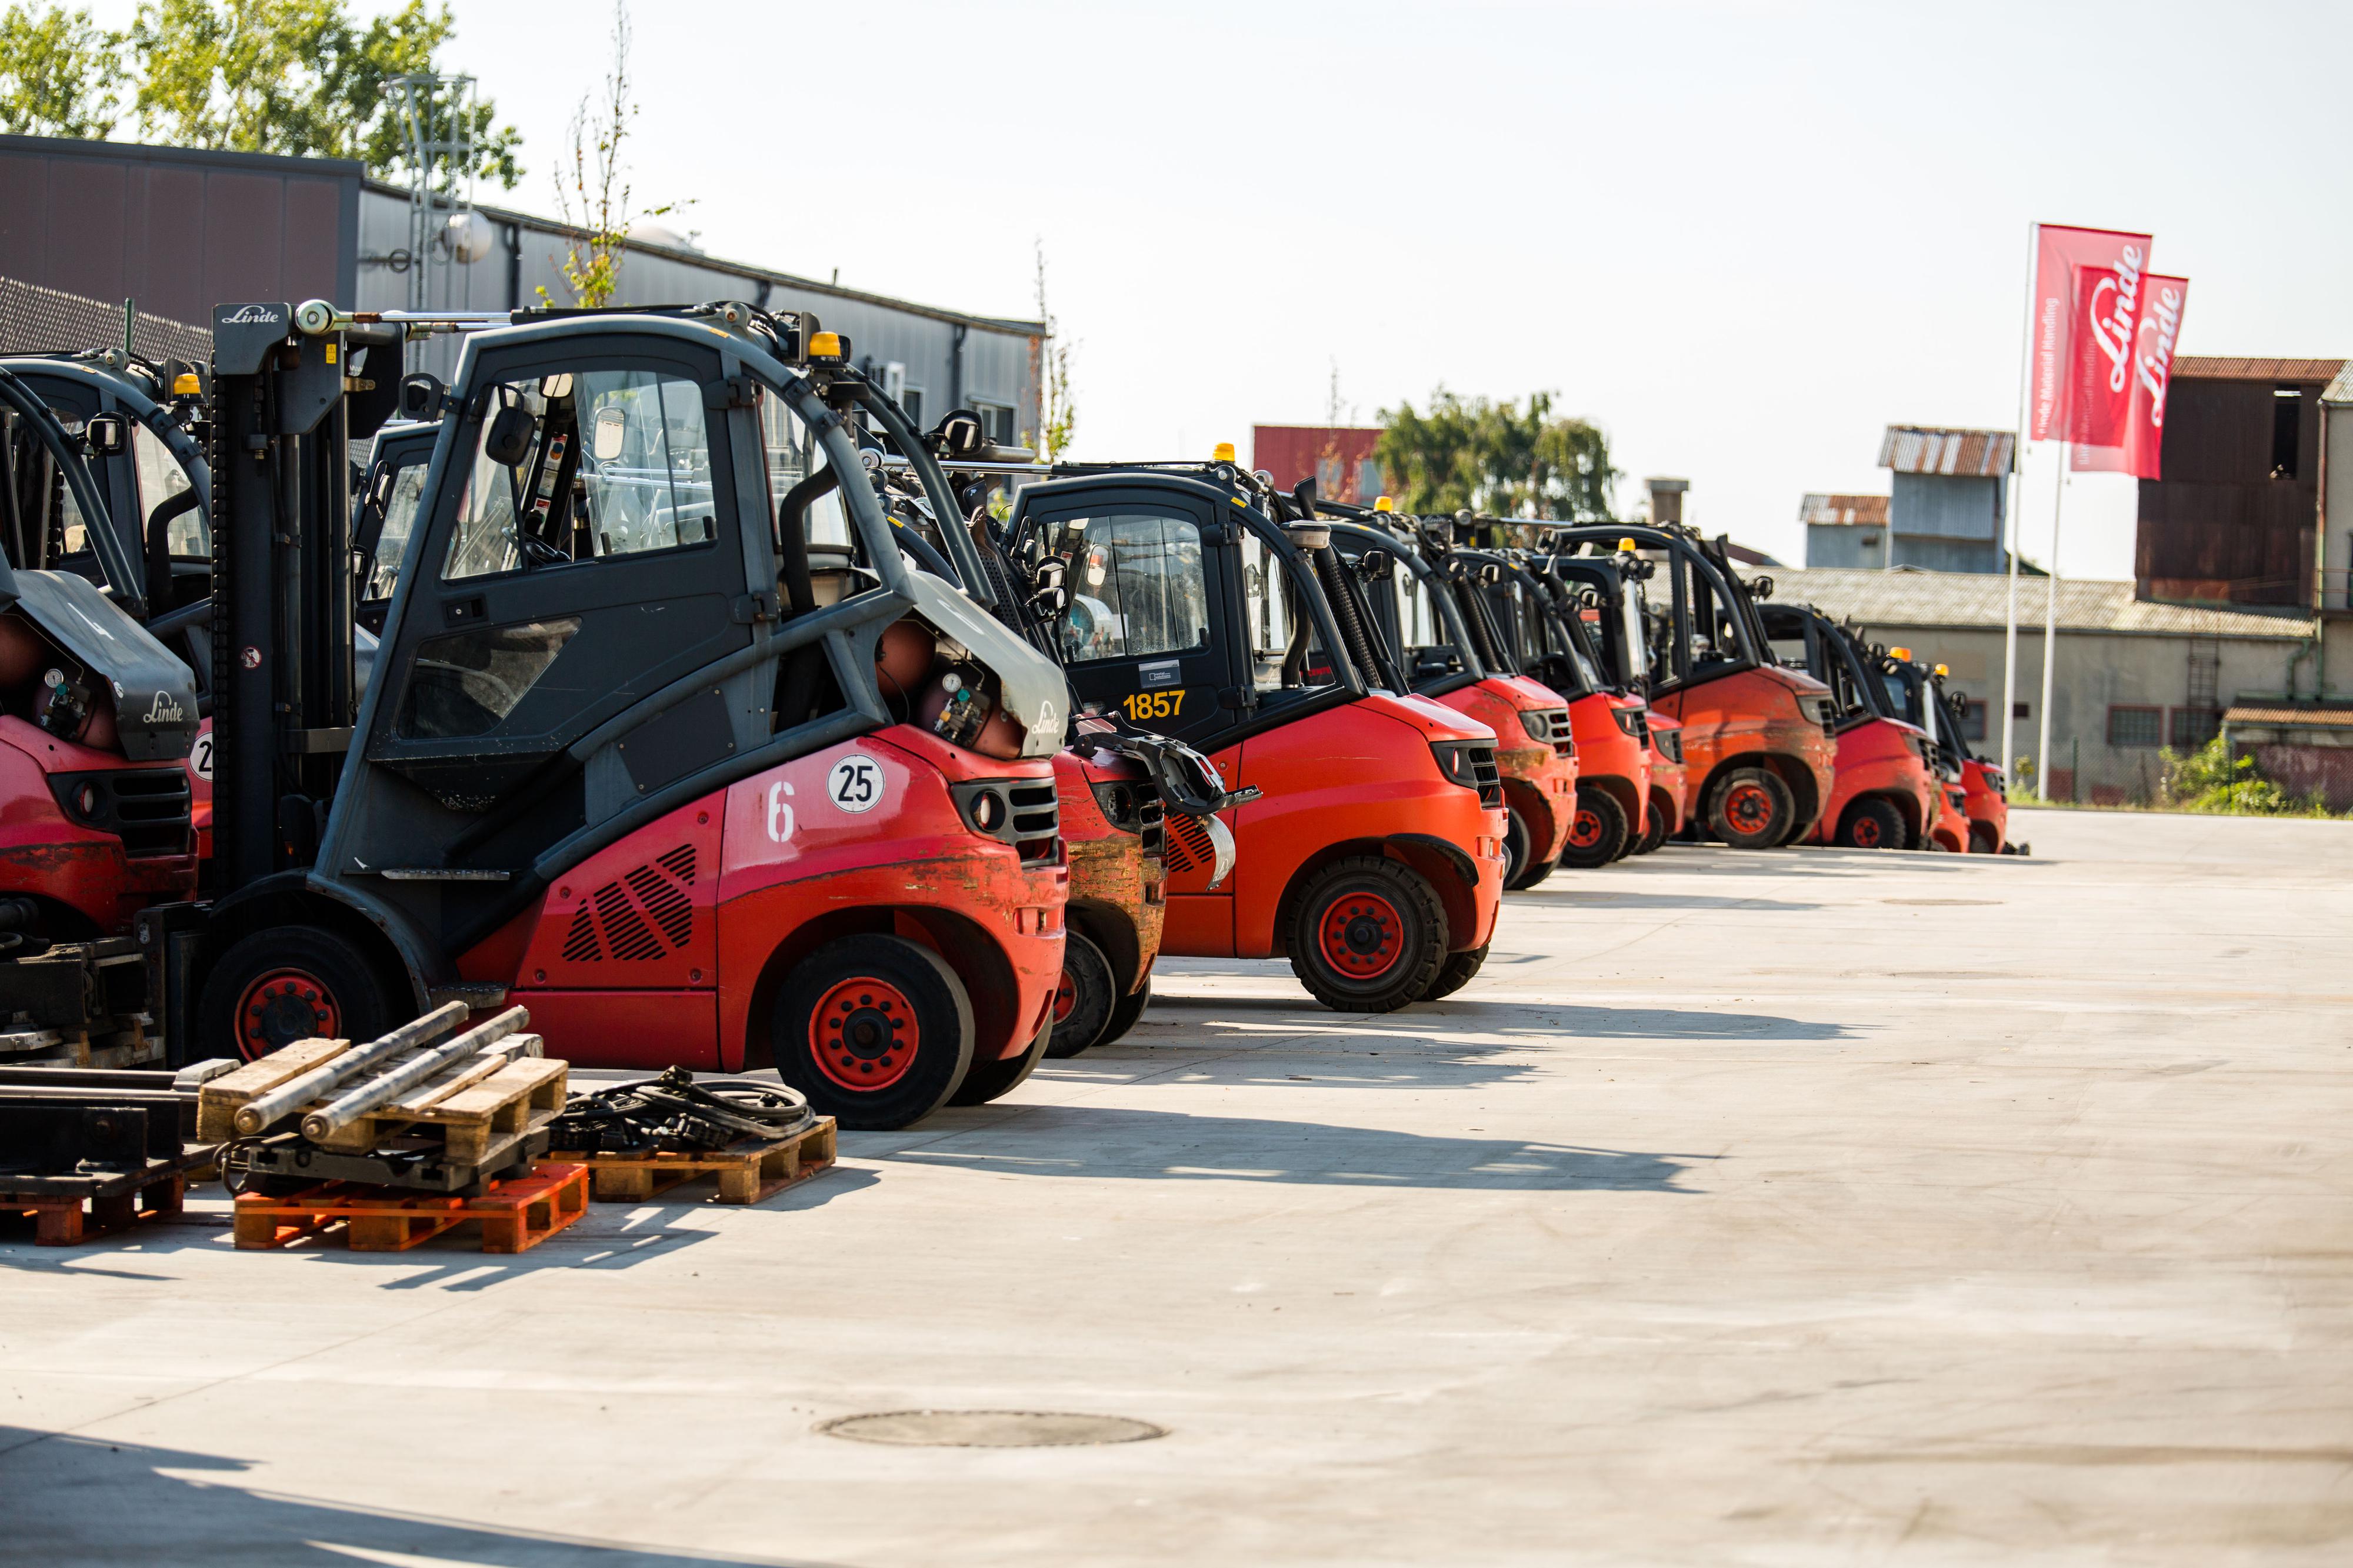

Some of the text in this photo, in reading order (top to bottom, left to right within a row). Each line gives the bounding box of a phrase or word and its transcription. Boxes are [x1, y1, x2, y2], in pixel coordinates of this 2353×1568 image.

[221, 305, 279, 323] Linde
[2041, 298, 2060, 351] Handling
[2090, 245, 2142, 393] Linde
[2039, 352, 2055, 401] Material
[2135, 287, 2181, 427] Linde
[143, 690, 184, 723] Linde
[1032, 700, 1059, 734] Linde
[1123, 690, 1185, 720] 1857
[838, 765, 873, 802] 25
[768, 781, 795, 842] 6
